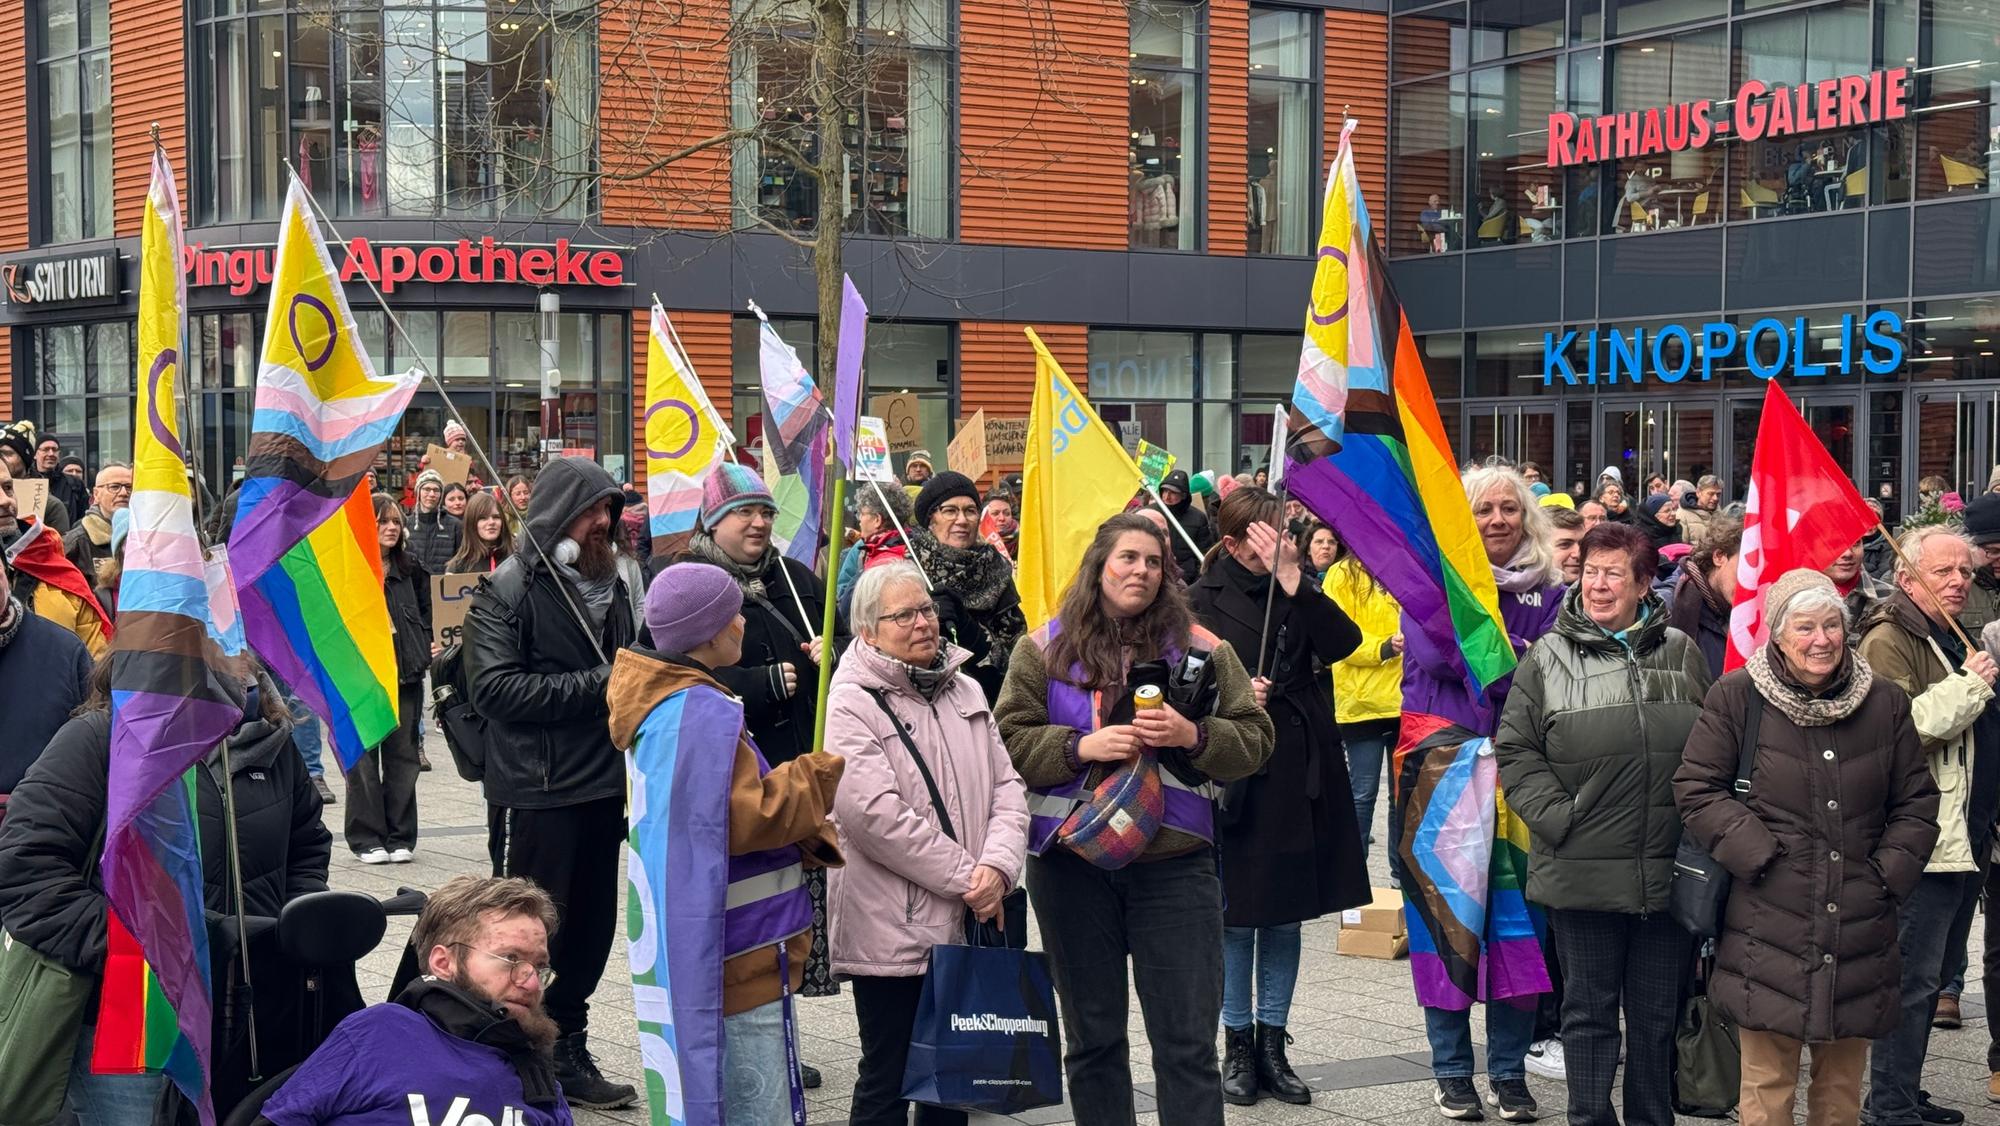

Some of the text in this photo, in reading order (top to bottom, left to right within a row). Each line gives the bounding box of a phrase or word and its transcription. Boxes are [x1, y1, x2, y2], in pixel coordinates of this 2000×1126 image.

[1547, 67, 1907, 168] RATHAUS-GALERIE
[34, 256, 106, 302] SATURN
[340, 236, 623, 293] Apotheke
[1544, 311, 1903, 385] KINOPOLIS
